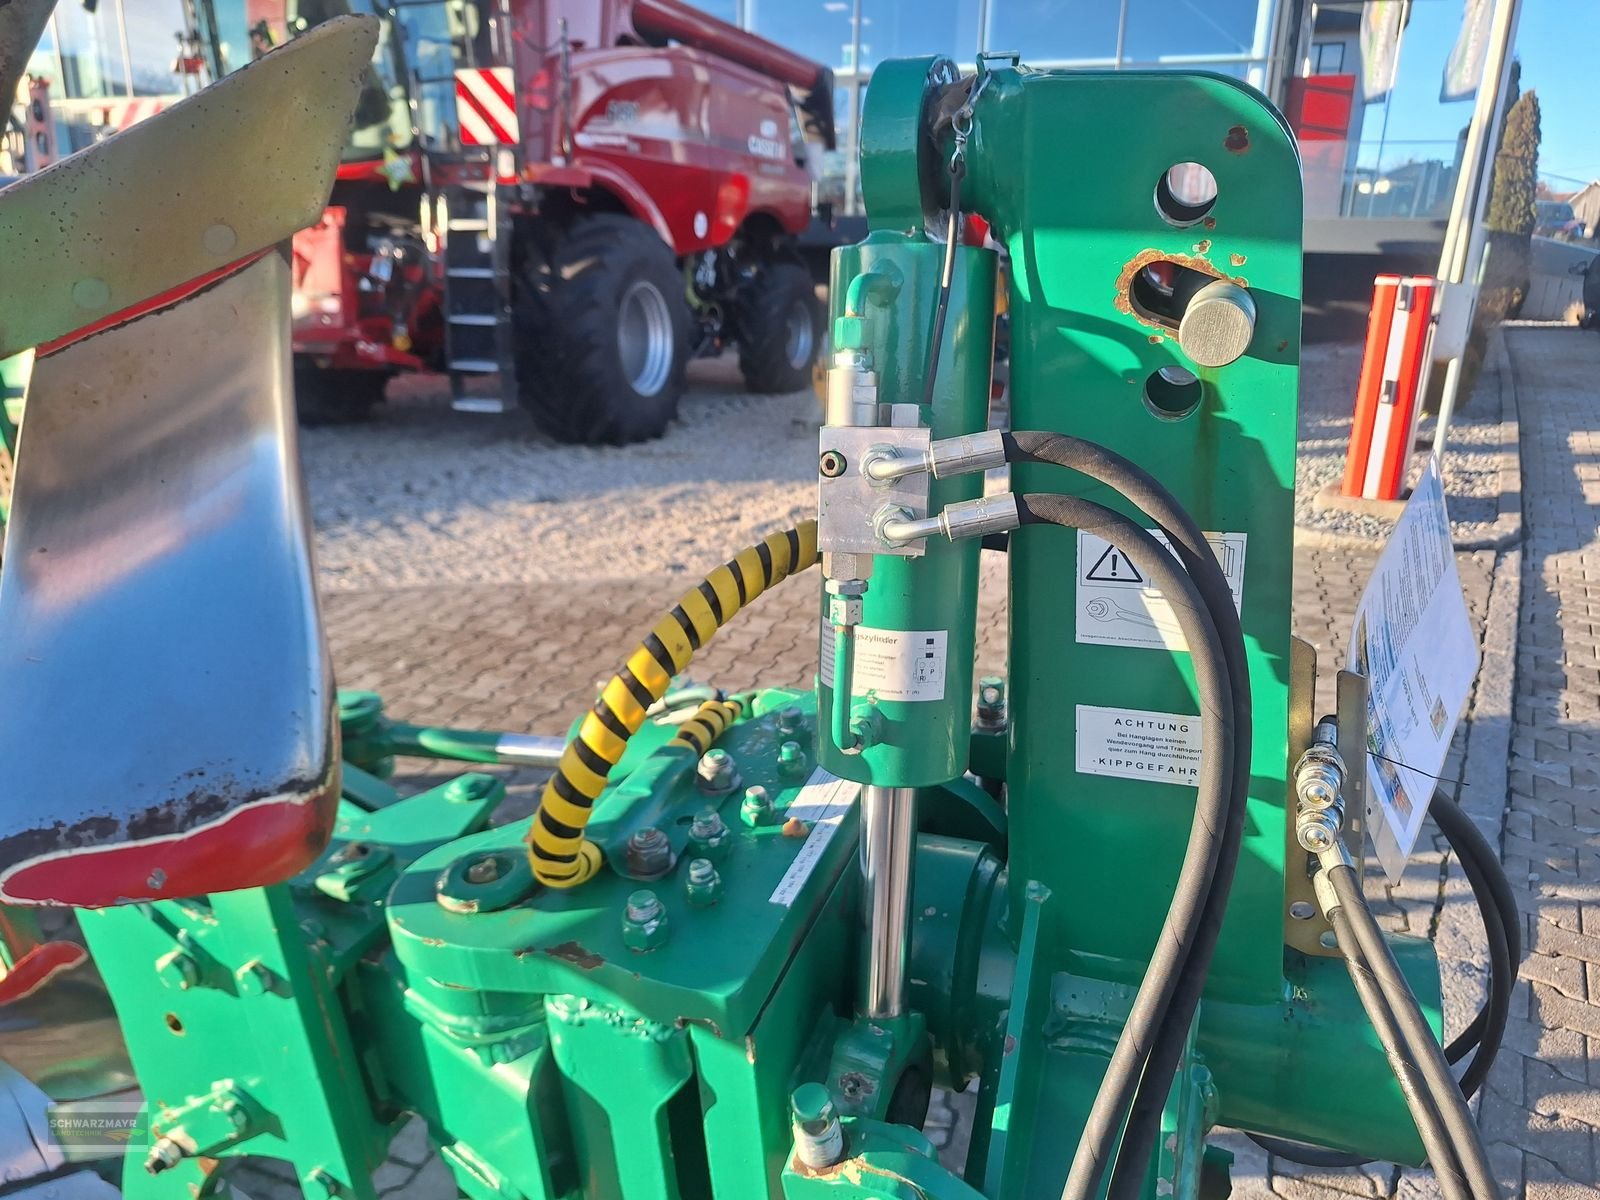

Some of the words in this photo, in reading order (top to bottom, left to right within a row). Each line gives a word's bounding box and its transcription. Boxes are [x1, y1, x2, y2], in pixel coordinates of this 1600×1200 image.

[1114, 718, 1189, 733] ACHTUNG
[1129, 733, 1164, 742] Hanglagen
[1106, 739, 1155, 750] Wendevorgang
[1139, 749, 1156, 757] Hang
[1157, 752, 1200, 761] durchführen!
[1098, 757, 1198, 776] KIPPGEFAHR
